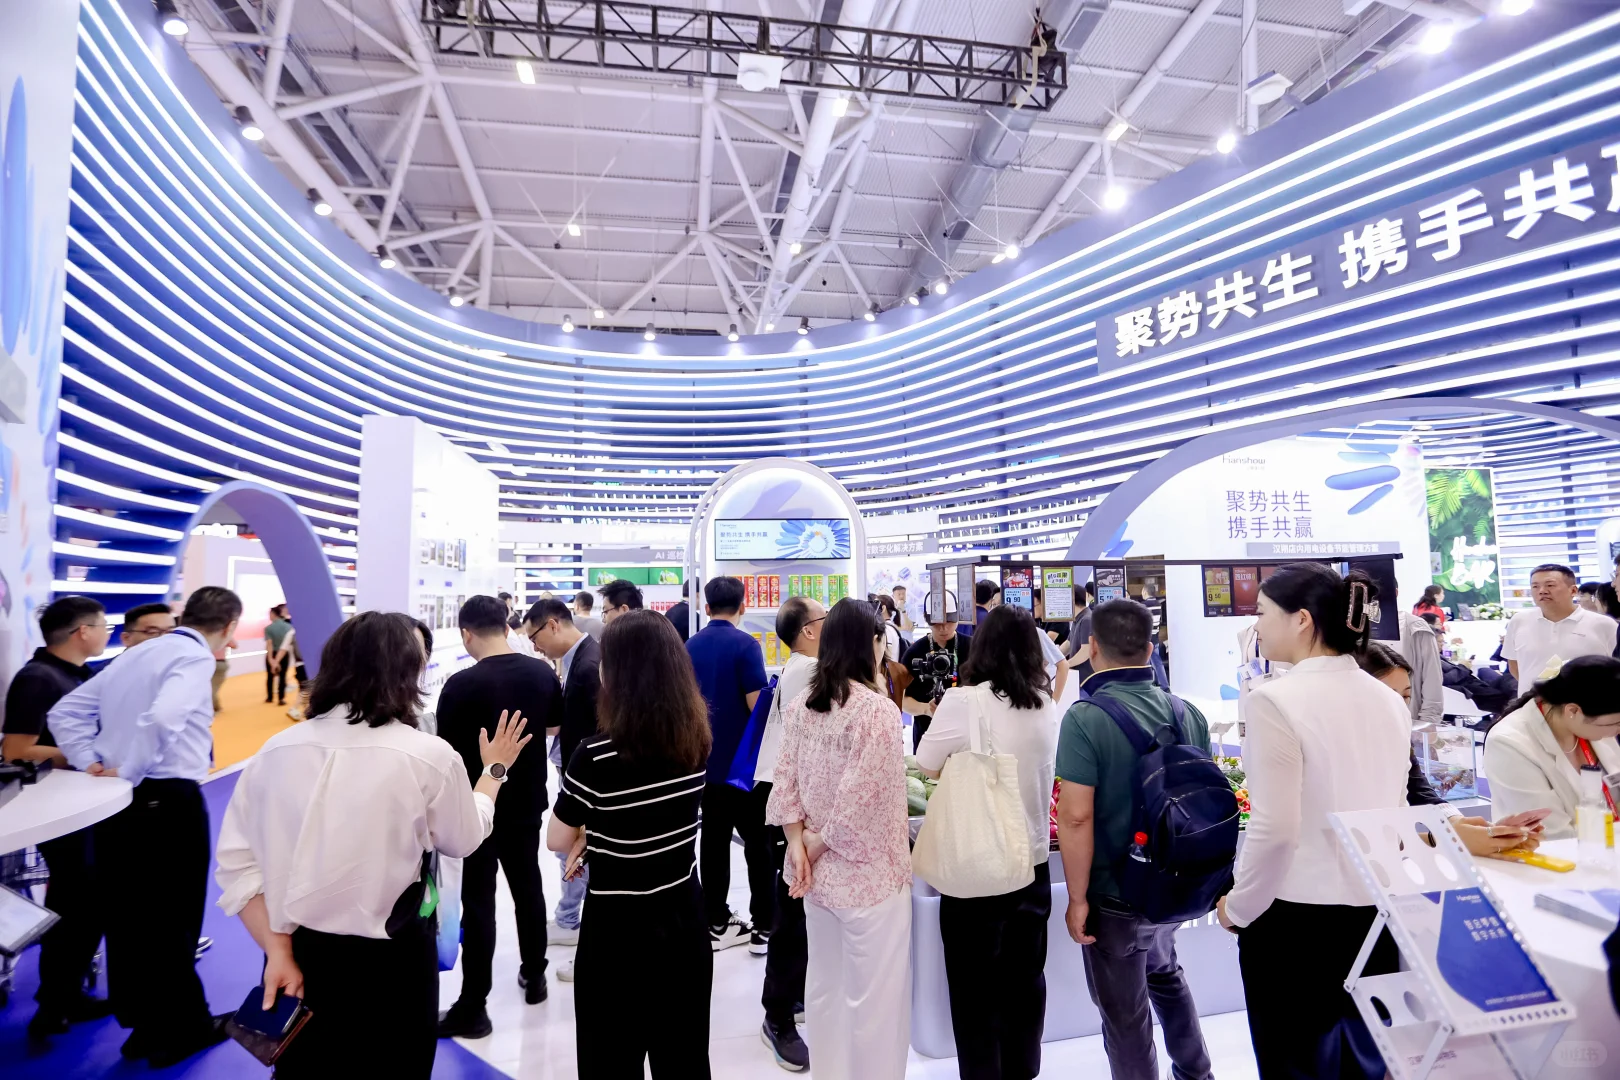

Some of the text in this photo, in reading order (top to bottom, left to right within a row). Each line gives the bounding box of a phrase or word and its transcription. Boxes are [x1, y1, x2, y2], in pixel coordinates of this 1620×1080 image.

[1114, 251, 1320, 358] 聚势共生
[1226, 490, 1312, 513] 聚势共生
[1228, 516, 1314, 539] 携手共赢
[655, 551, 665, 560] AI
